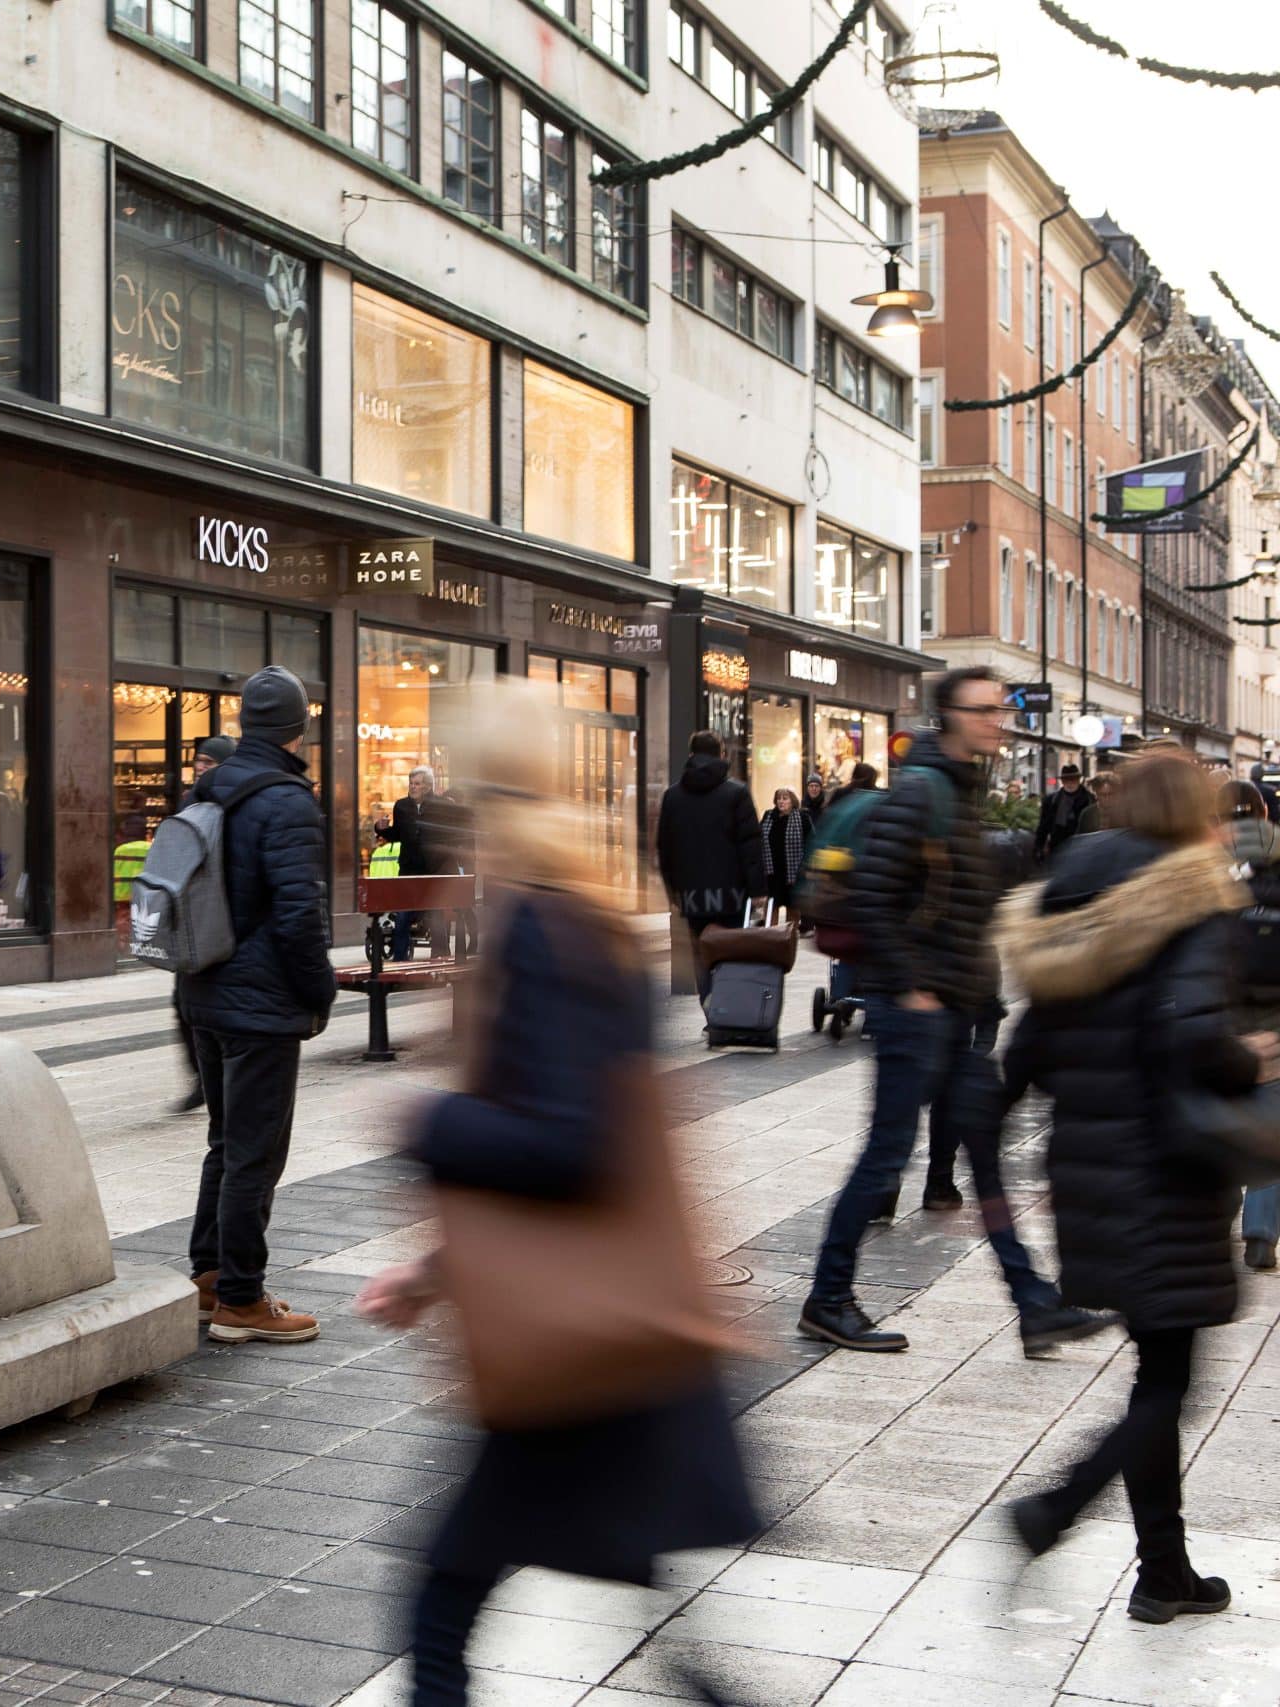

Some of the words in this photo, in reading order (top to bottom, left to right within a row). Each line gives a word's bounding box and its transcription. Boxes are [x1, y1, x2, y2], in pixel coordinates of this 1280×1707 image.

[199, 515, 269, 573] KICKS
[360, 550, 420, 564] ZARA
[357, 569, 422, 583] HOME
